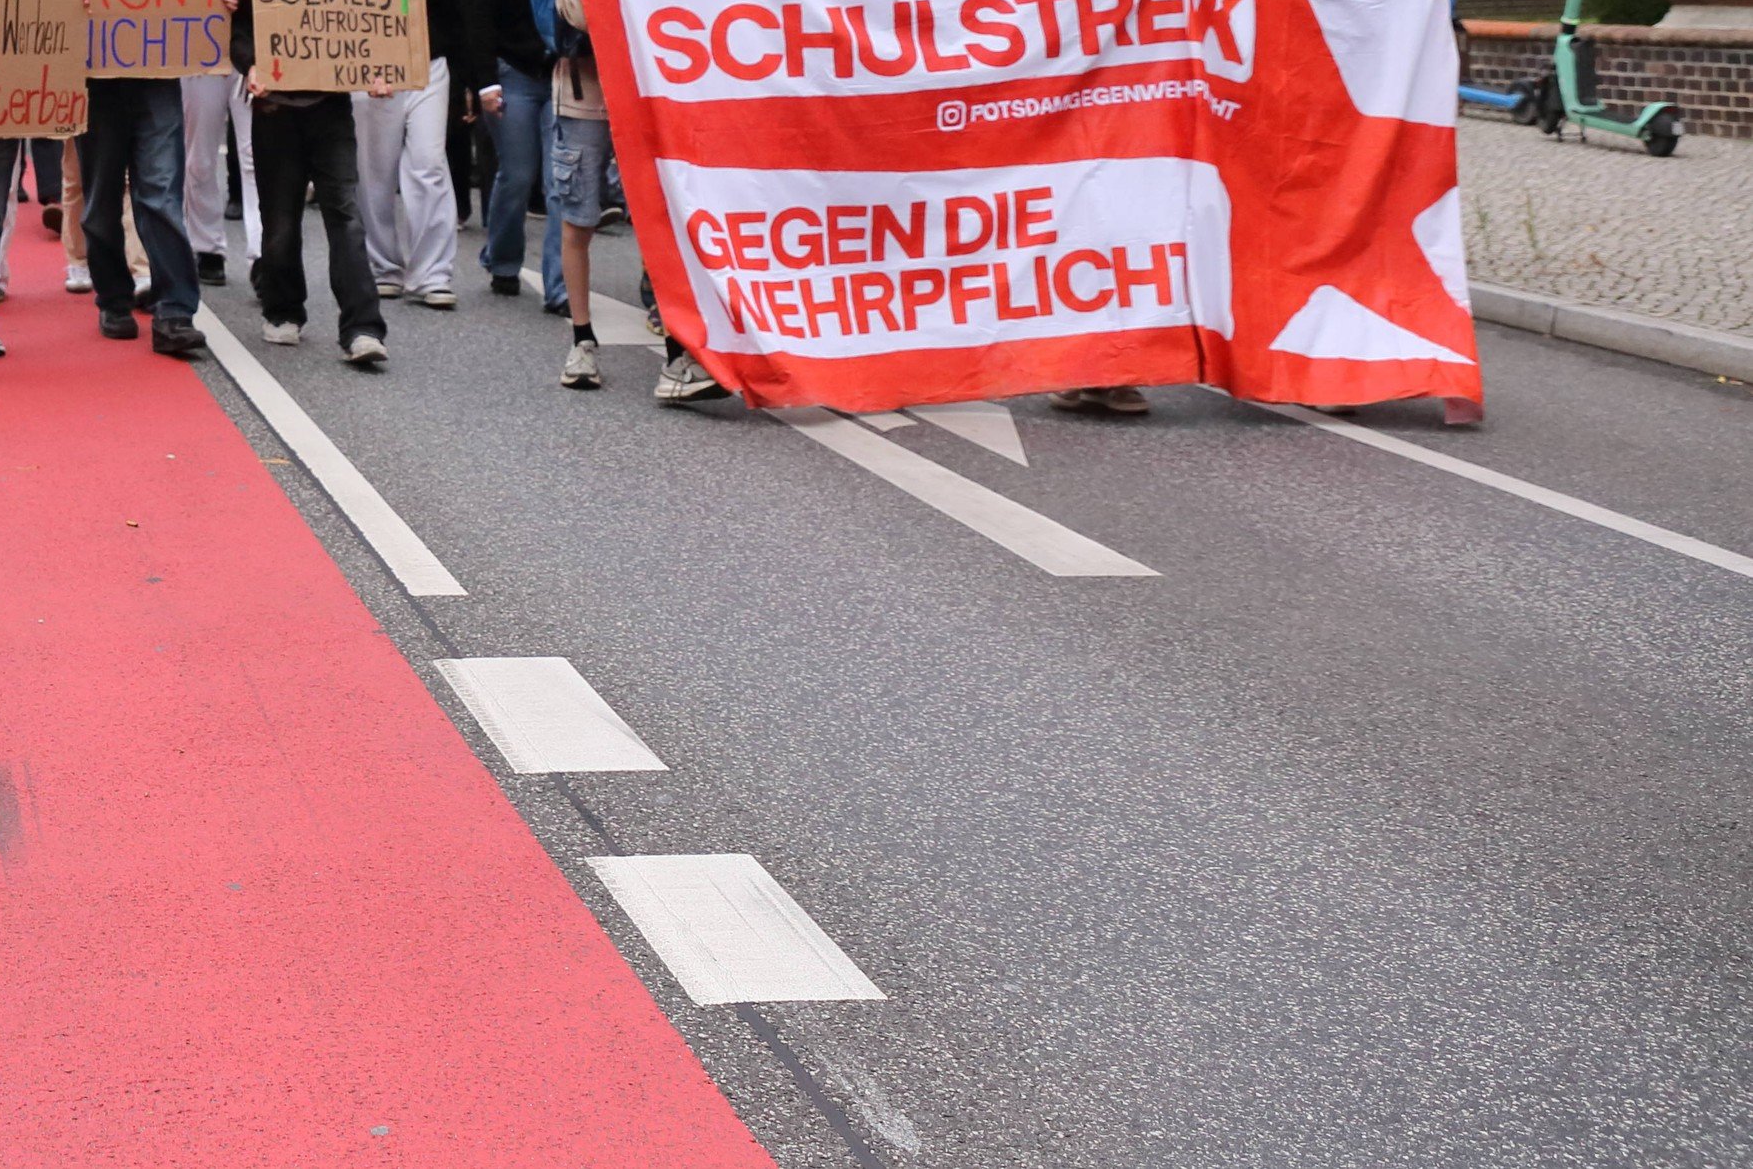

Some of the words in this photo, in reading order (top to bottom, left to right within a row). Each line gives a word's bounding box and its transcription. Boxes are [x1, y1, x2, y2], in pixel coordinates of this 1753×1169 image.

[300, 8, 408, 38] AUFRÜSTEN
[270, 28, 371, 60] RÜSTUNG
[334, 61, 406, 86] KÜRZEN
[686, 200, 927, 272] GEGEN
[945, 186, 1057, 257] DIE
